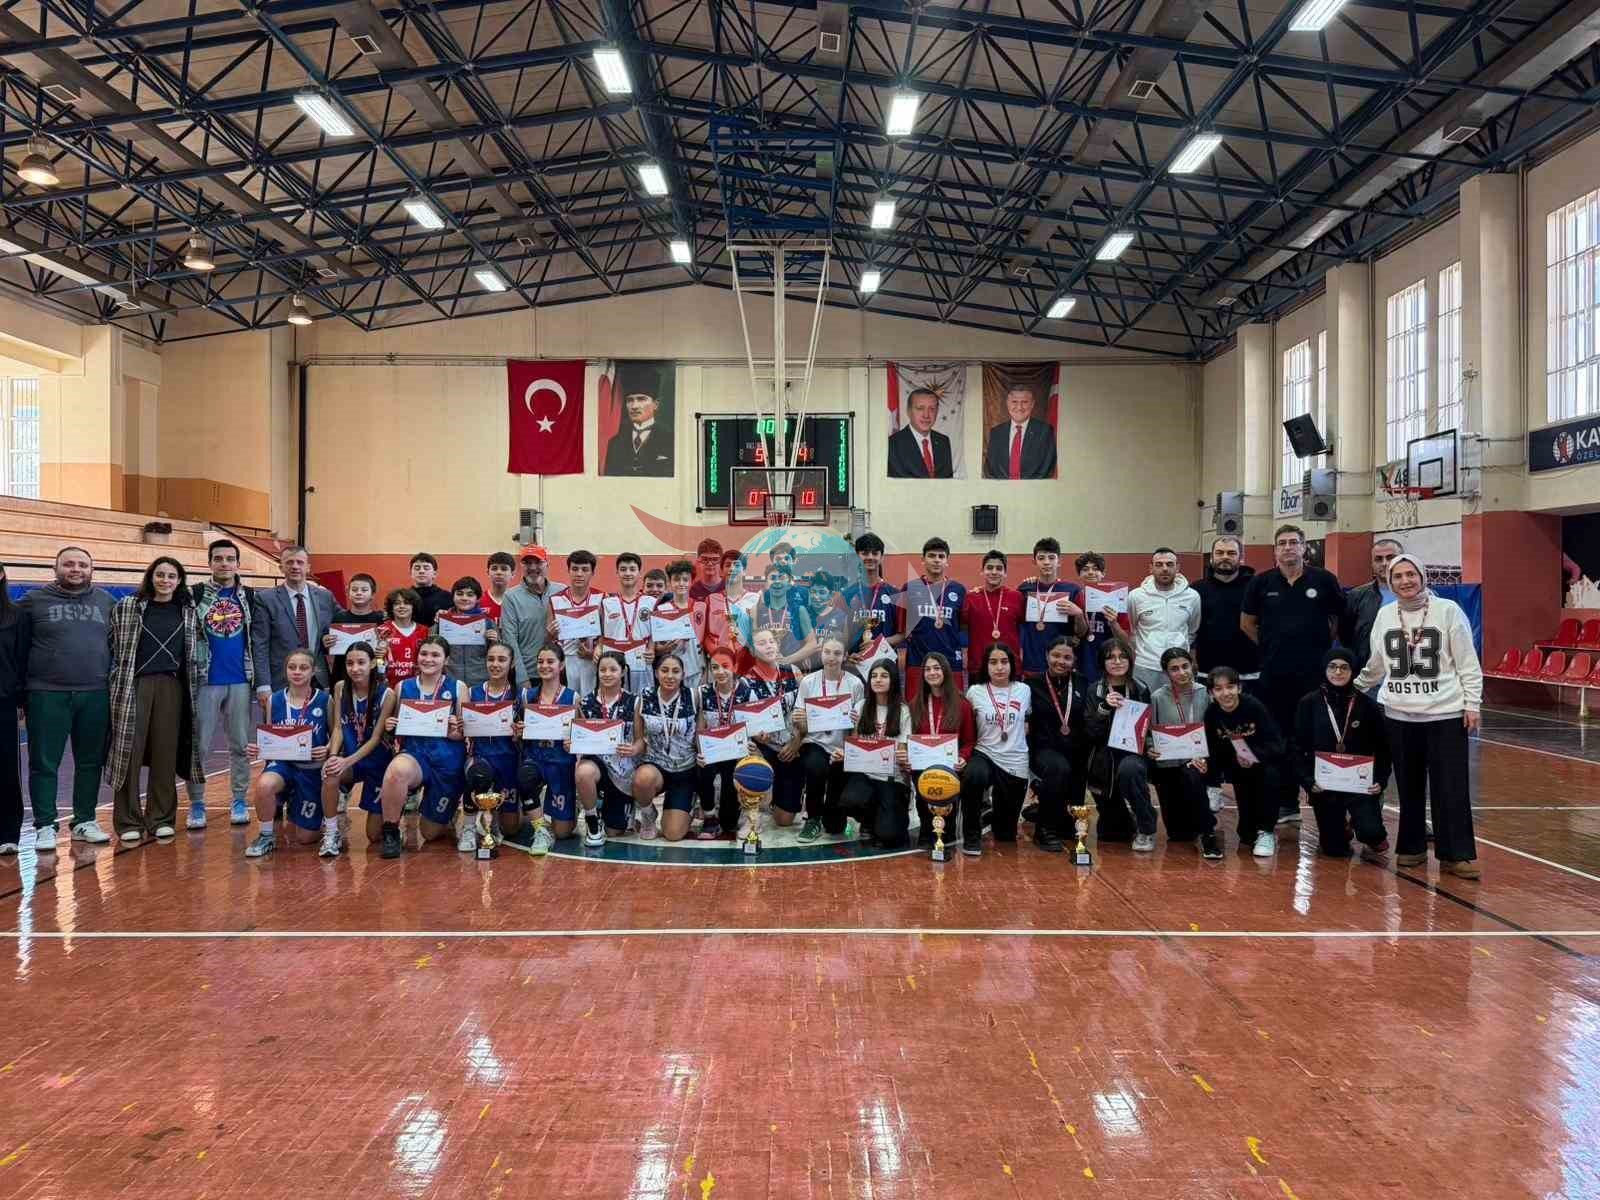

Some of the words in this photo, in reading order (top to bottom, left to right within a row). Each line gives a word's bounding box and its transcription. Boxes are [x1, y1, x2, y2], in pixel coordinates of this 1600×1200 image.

[1384, 627, 1443, 680] 93
[1387, 680, 1440, 694] BOSTON
[301, 800, 317, 819] 13
